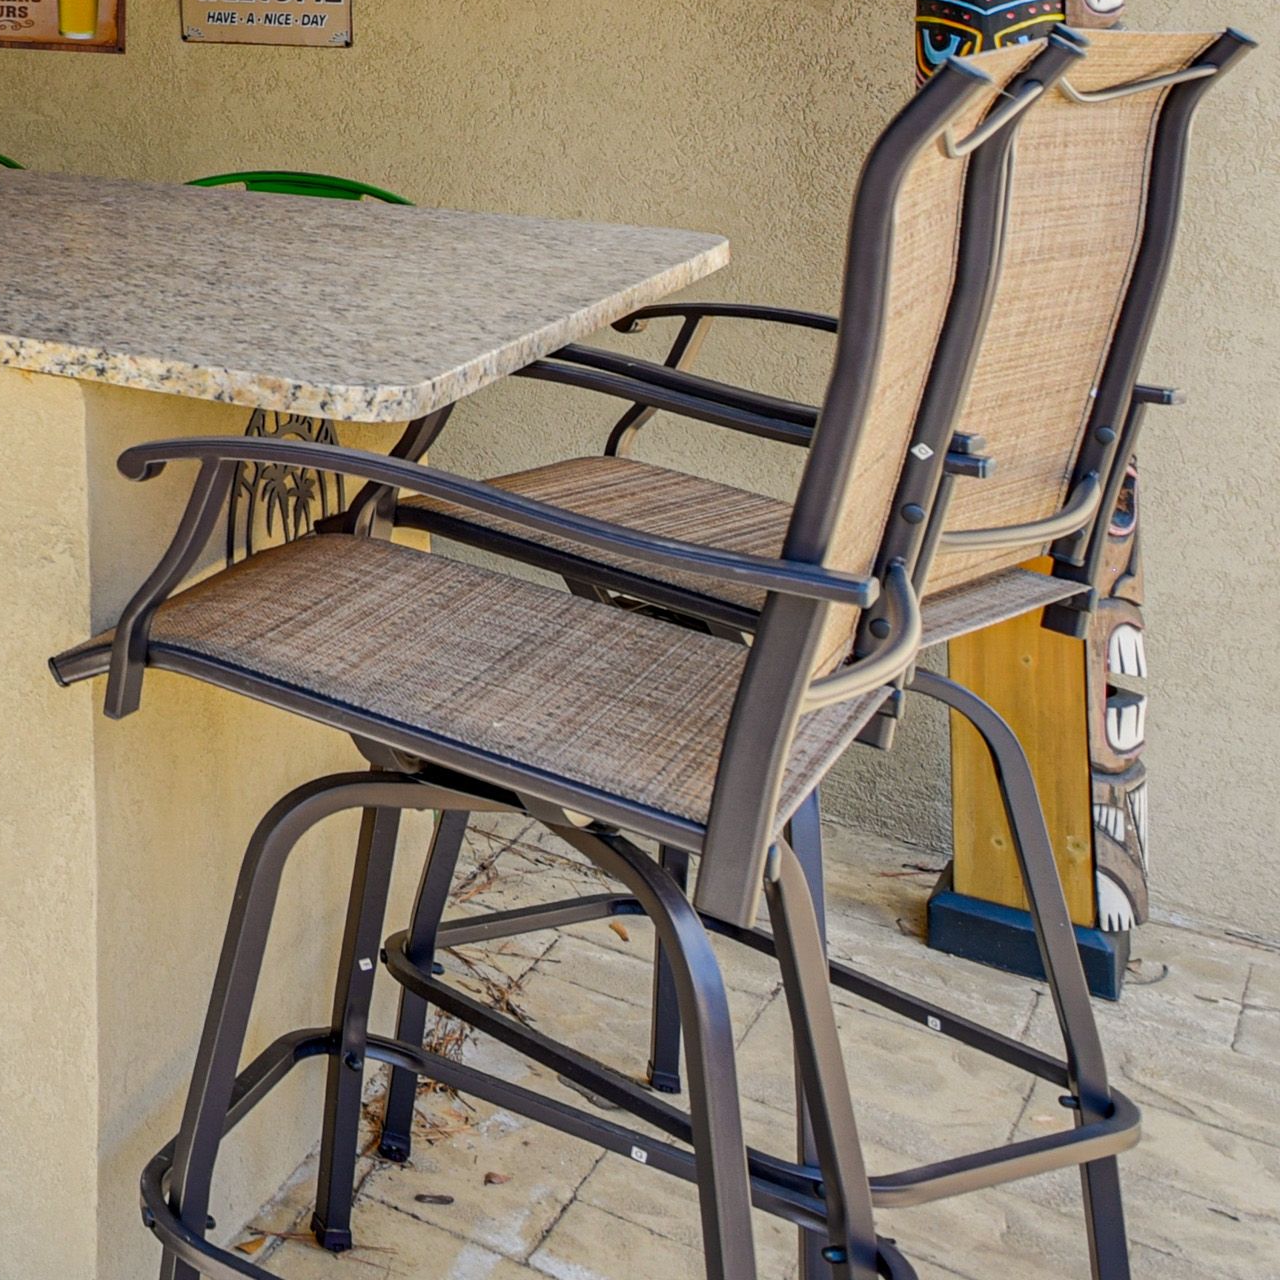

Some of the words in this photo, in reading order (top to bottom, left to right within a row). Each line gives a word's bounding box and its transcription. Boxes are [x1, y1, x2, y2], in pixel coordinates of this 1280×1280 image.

[207, 11, 237, 24] HAVE
[246, 12, 255, 25] A
[264, 13, 292, 26] NICE
[301, 14, 327, 27] DAY
